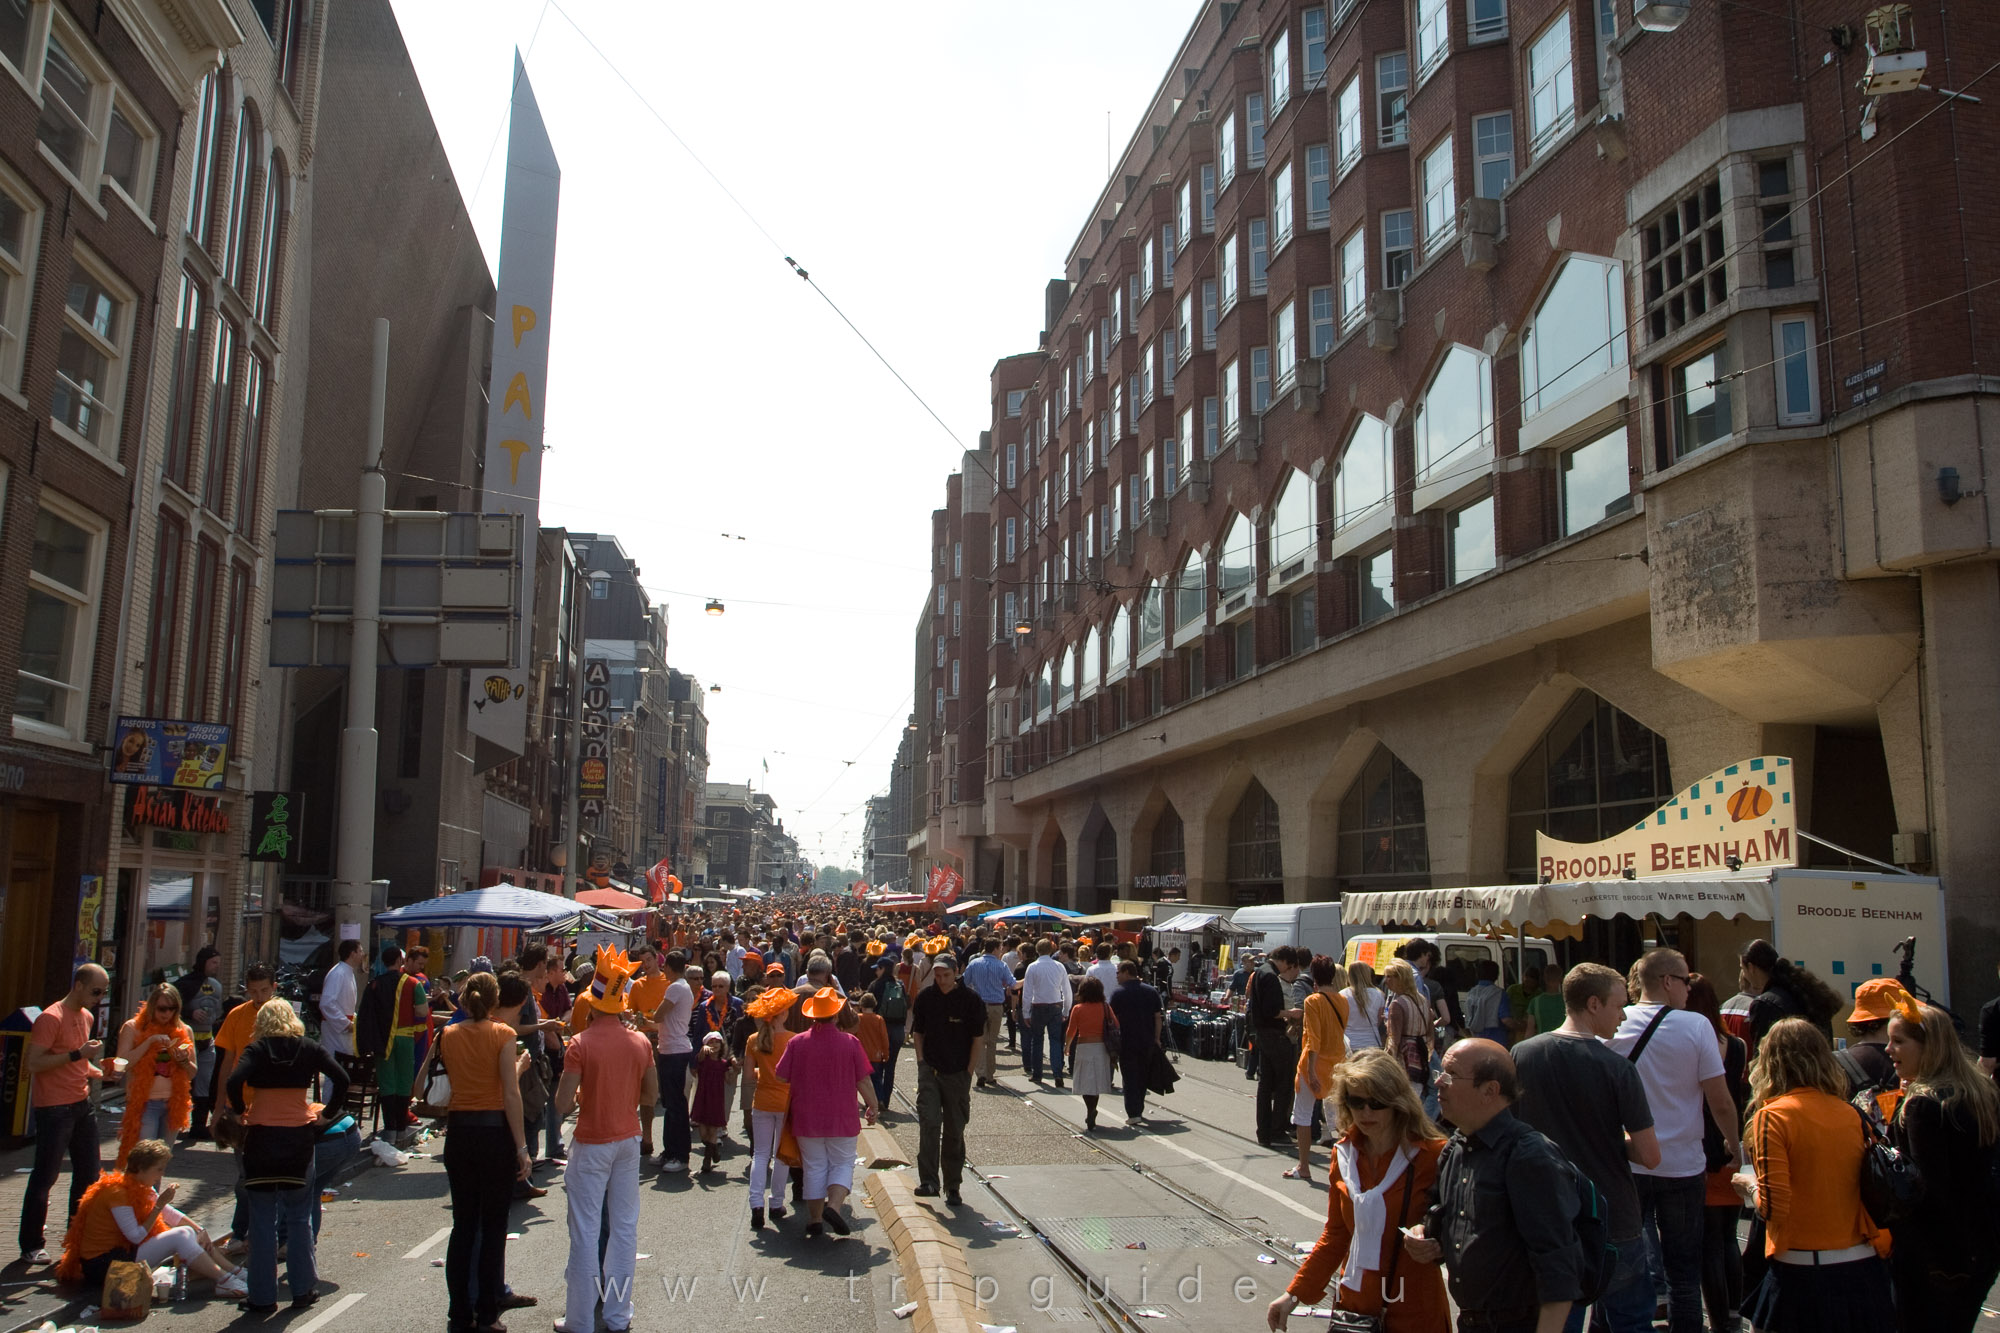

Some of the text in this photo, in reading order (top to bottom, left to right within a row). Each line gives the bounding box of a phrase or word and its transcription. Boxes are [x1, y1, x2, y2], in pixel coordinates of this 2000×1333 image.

[500, 305, 537, 514] PAT
[120, 719, 157, 729] PASFOTO'S
[192, 724, 226, 735] digital
[187, 731, 219, 741] photo
[583, 664, 606, 813] AUROA
[176, 768, 200, 784] 15
[131, 785, 176, 829] Asian
[1540, 827, 1790, 881] BROODJE BEENHAM
[1697, 891, 1746, 902] BEENHAM
[1797, 904, 1923, 920] BROODJE BEENHAM
